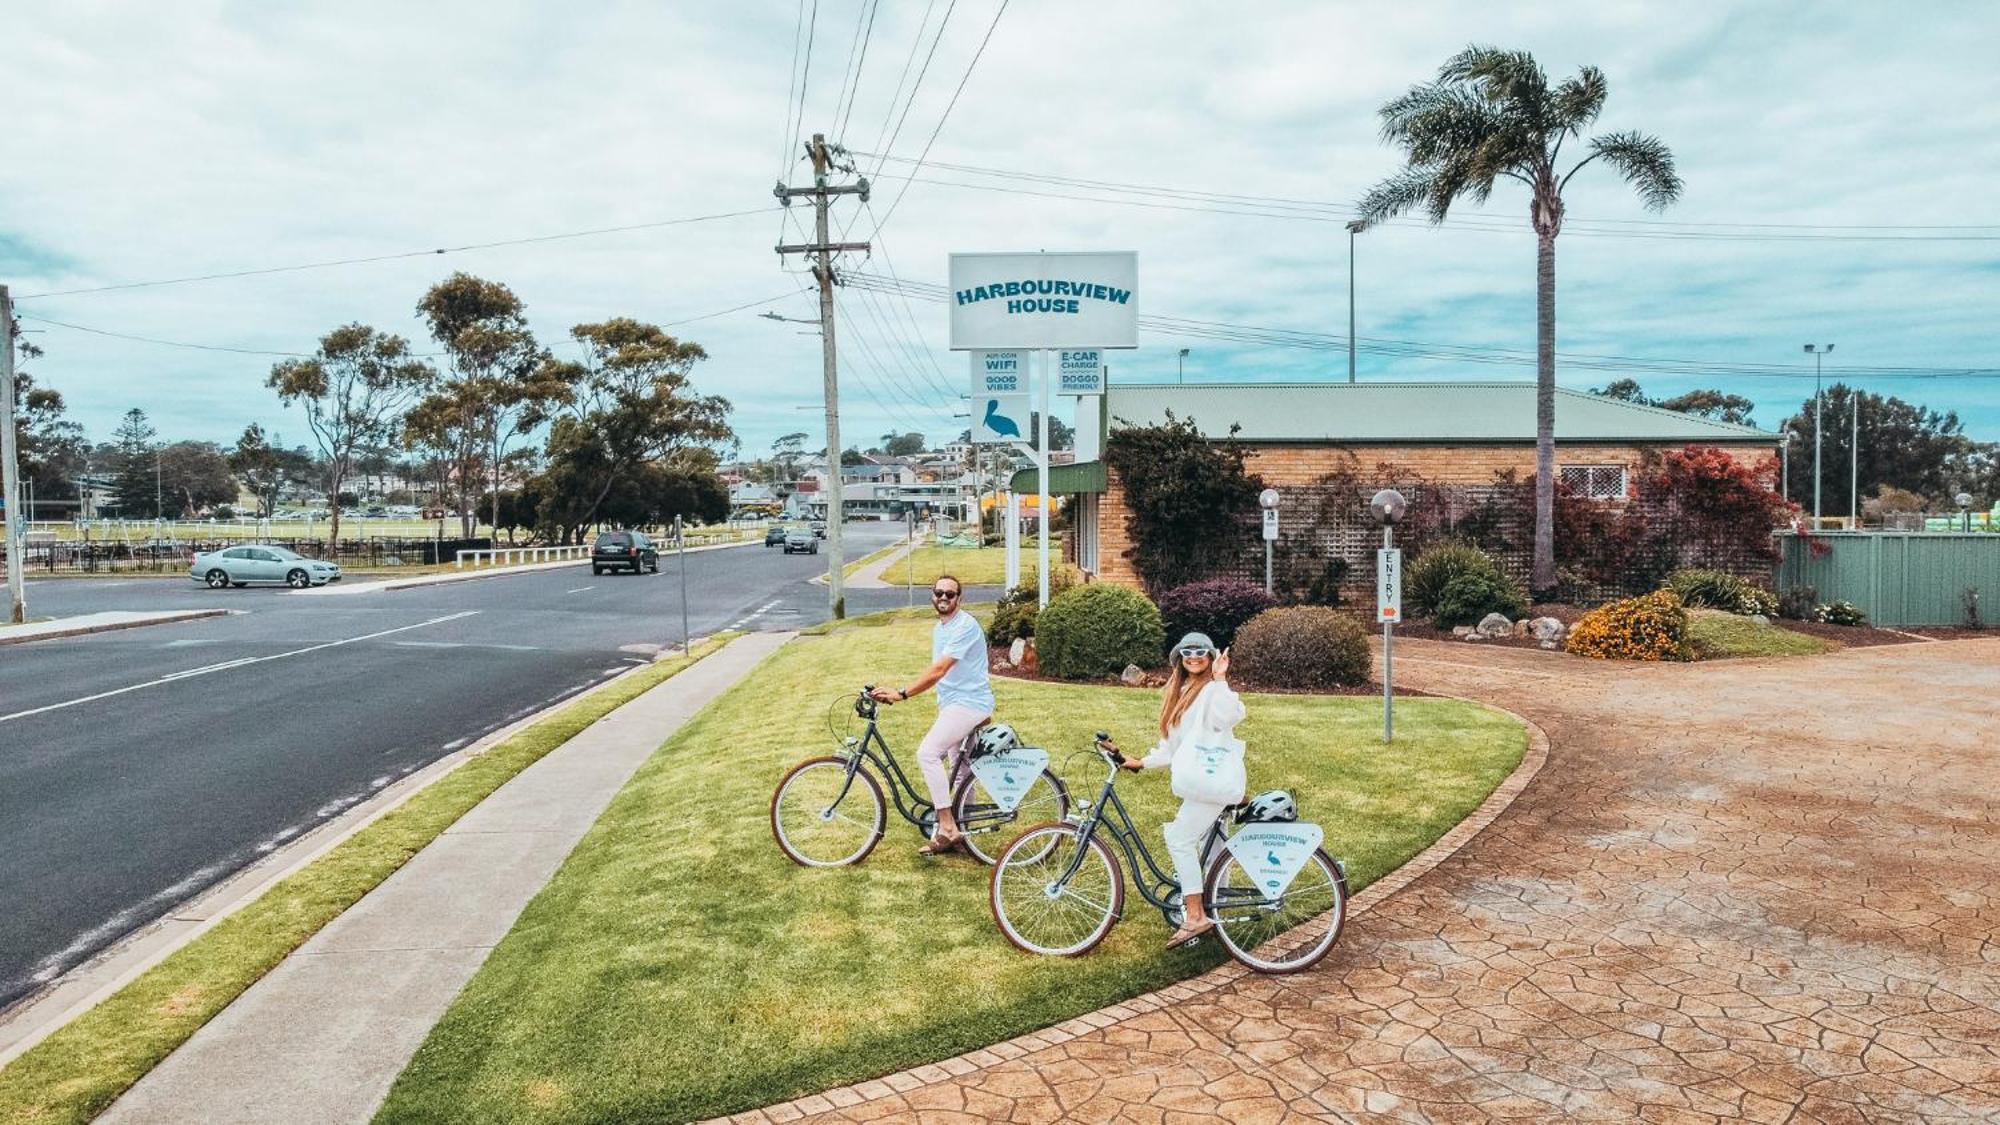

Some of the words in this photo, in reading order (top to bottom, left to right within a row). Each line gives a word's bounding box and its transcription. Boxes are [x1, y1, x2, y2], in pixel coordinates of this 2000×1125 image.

[956, 279, 1131, 306] HARBOURVIEW
[1007, 299, 1080, 314] HOUSE
[1062, 352, 1098, 361] E-CAR
[986, 360, 1017, 370] WIFI
[1062, 375, 1099, 383] DOGGO
